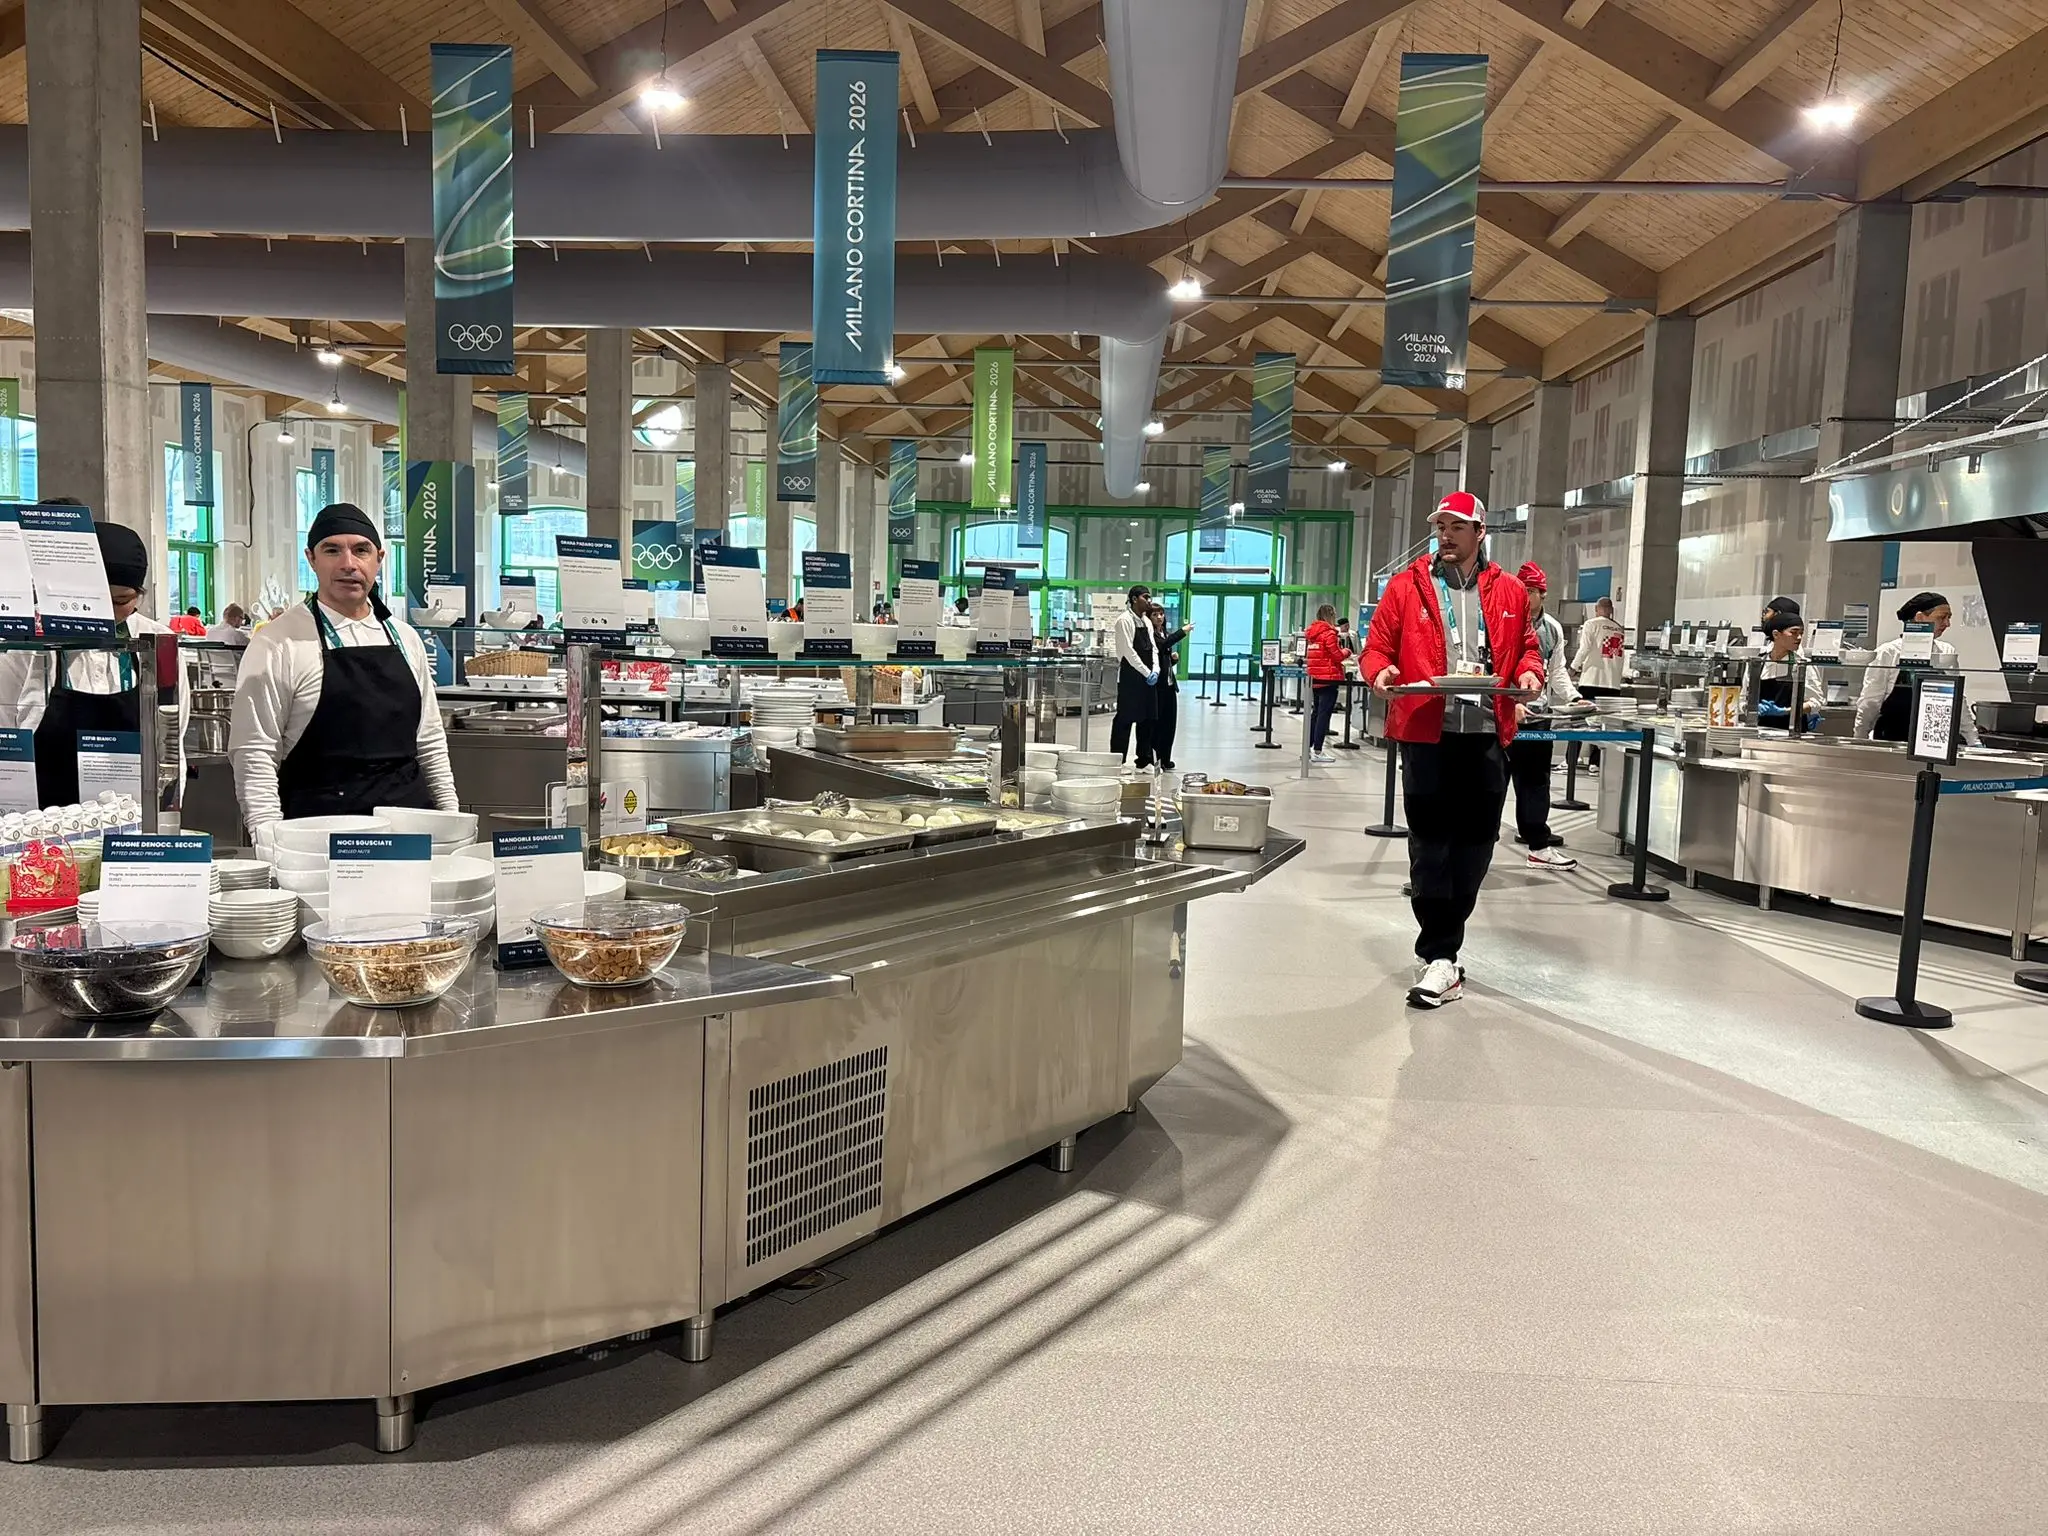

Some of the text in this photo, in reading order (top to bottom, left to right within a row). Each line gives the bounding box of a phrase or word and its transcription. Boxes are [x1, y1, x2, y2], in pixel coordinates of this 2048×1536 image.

[845, 79, 867, 353] MILANO CORTINA 2026
[1397, 332, 1446, 344] MILANO
[1405, 342, 1453, 355] CORTINA
[1413, 353, 1437, 363] 2026
[987, 361, 999, 492] MILANO CORTINA 2026
[192, 392, 202, 495] MILANO CORTINA 2026
[423, 481, 437, 520] 2026
[1026, 451, 1037, 538] MILANO CORTINA 2026
[1543, 732, 1557, 740] 2026
[1961, 783, 1983, 791] MILANO
[1983, 782, 2004, 790] CORTINA
[499, 835, 531, 843] MANDORLE
